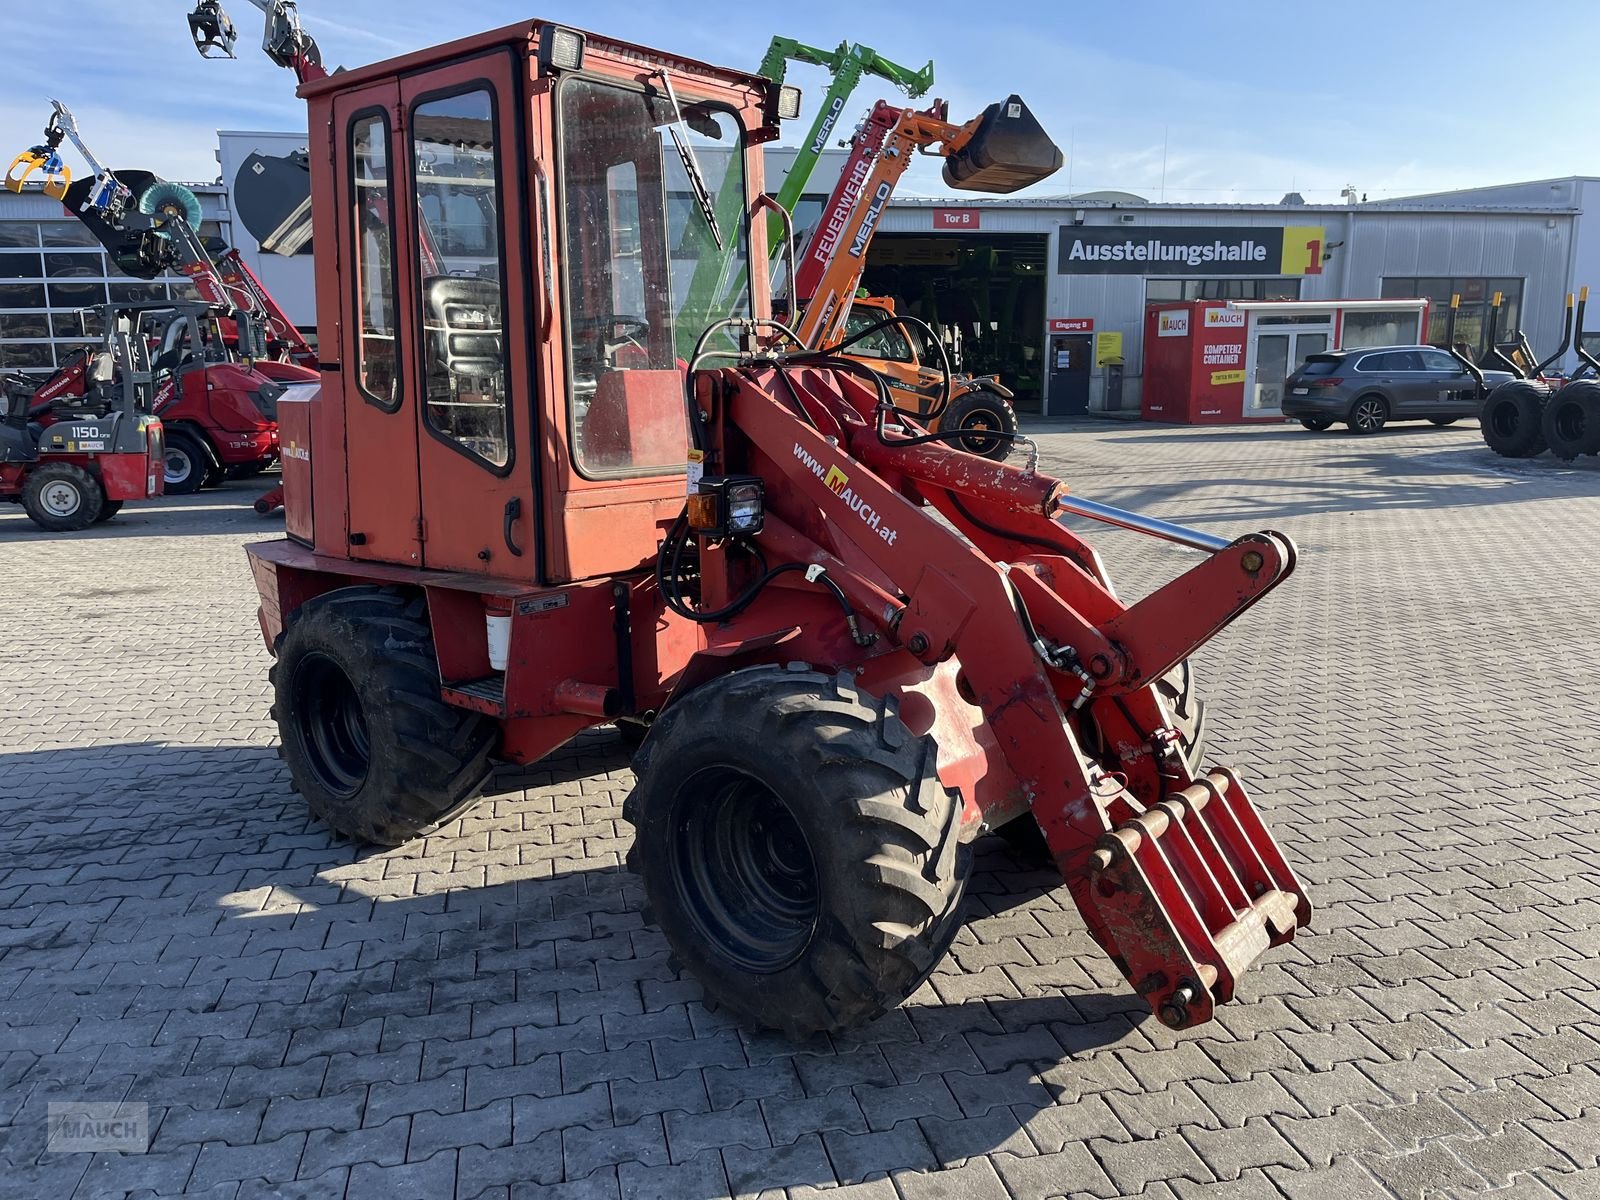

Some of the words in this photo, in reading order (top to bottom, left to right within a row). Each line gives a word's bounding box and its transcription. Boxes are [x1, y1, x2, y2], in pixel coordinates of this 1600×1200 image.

[587, 39, 716, 84] WEIDEMANN
[811, 97, 844, 154] MERLO
[813, 159, 870, 263] FEUERWEHR
[849, 182, 891, 257] MERLO
[944, 213, 961, 224] Tor
[962, 213, 970, 223] B
[1068, 239, 1267, 266] Ausstellungshalle
[1304, 239, 1323, 275] 1
[1210, 313, 1242, 324] MAUCH
[1055, 321, 1082, 330] Eingang
[1162, 319, 1187, 332] MAUCH
[1203, 344, 1242, 355] KOMPETENZ
[1203, 354, 1239, 365] CONTAINER
[39, 376, 71, 399] WEIDEMANN
[71, 426, 99, 439] 1150
[80, 442, 105, 450] MAUCH
[229, 441, 258, 449] 1390
[792, 442, 898, 546] www.MAUCH.at
